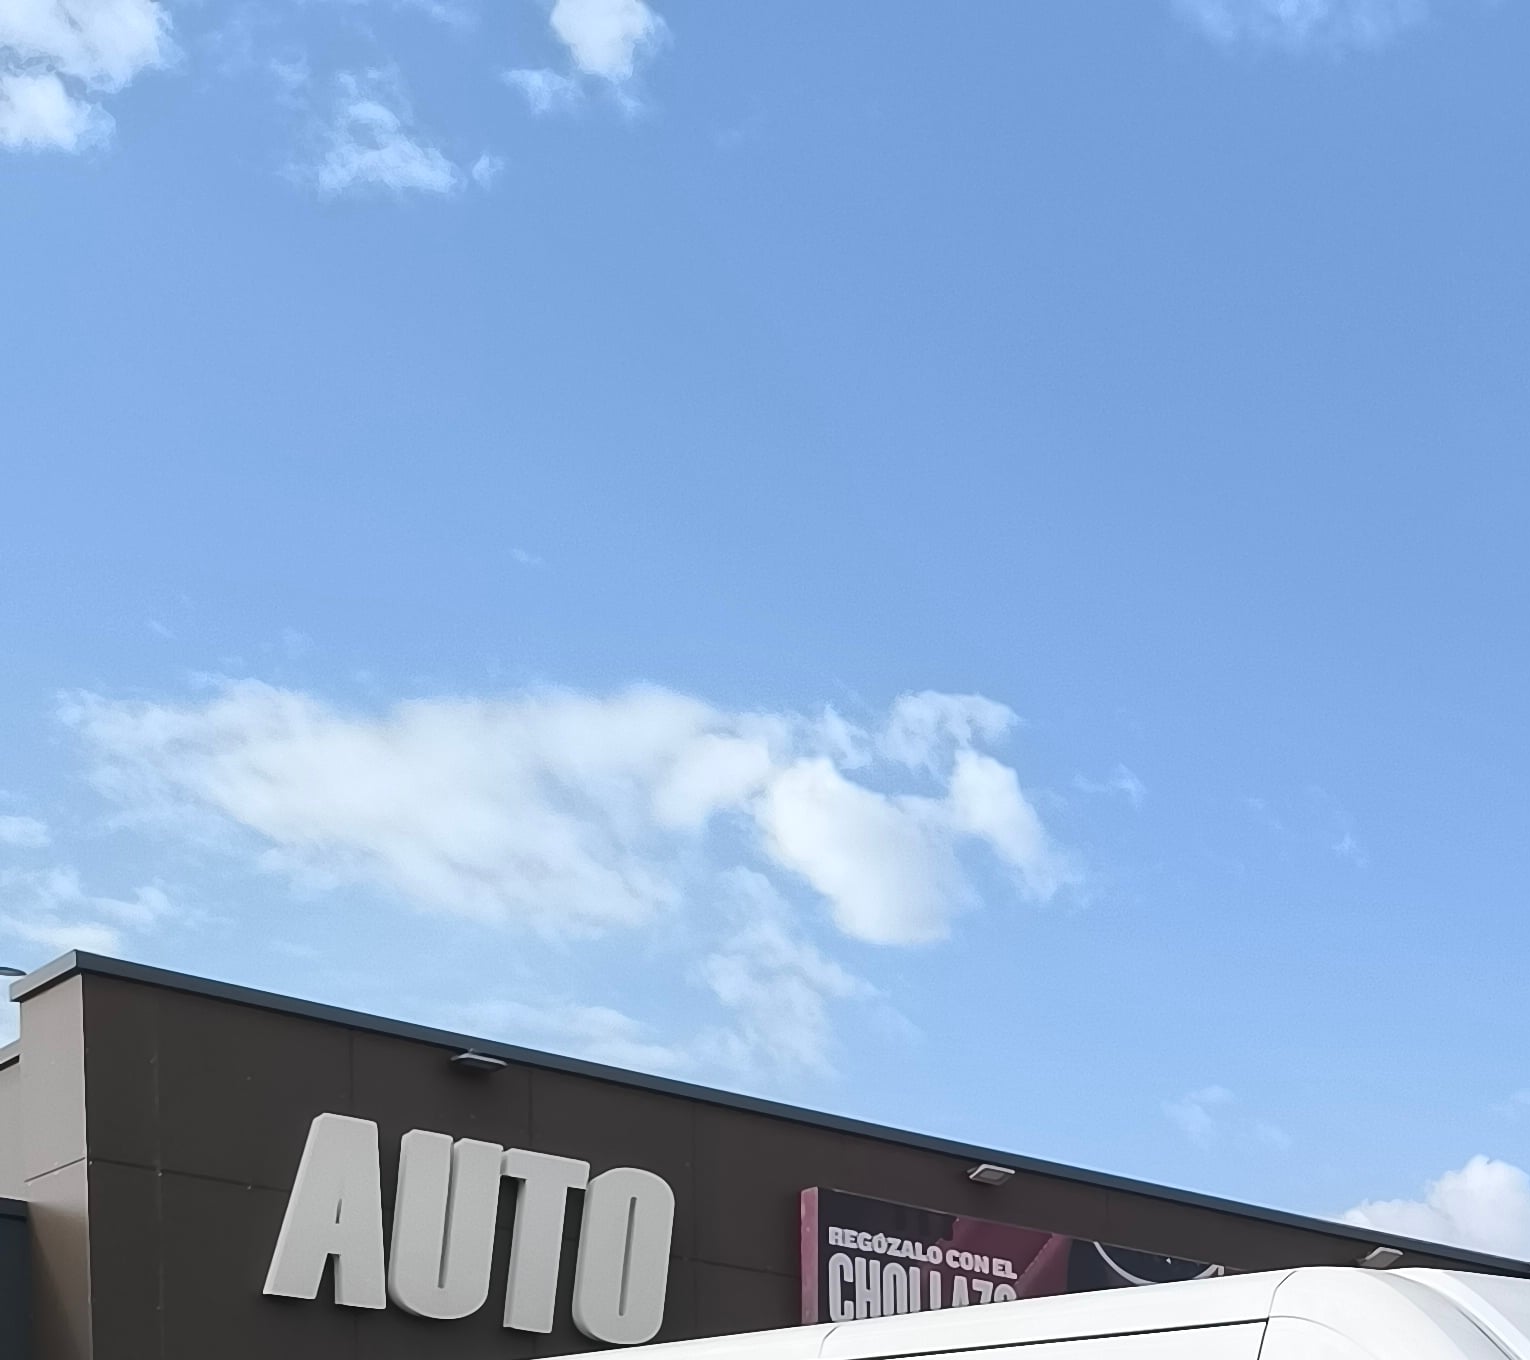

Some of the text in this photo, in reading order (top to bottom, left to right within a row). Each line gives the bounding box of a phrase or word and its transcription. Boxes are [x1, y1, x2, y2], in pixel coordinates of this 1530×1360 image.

[262, 1112, 676, 1345] AUTO
[828, 1226, 1018, 1280] REGÓZALO CON EL
